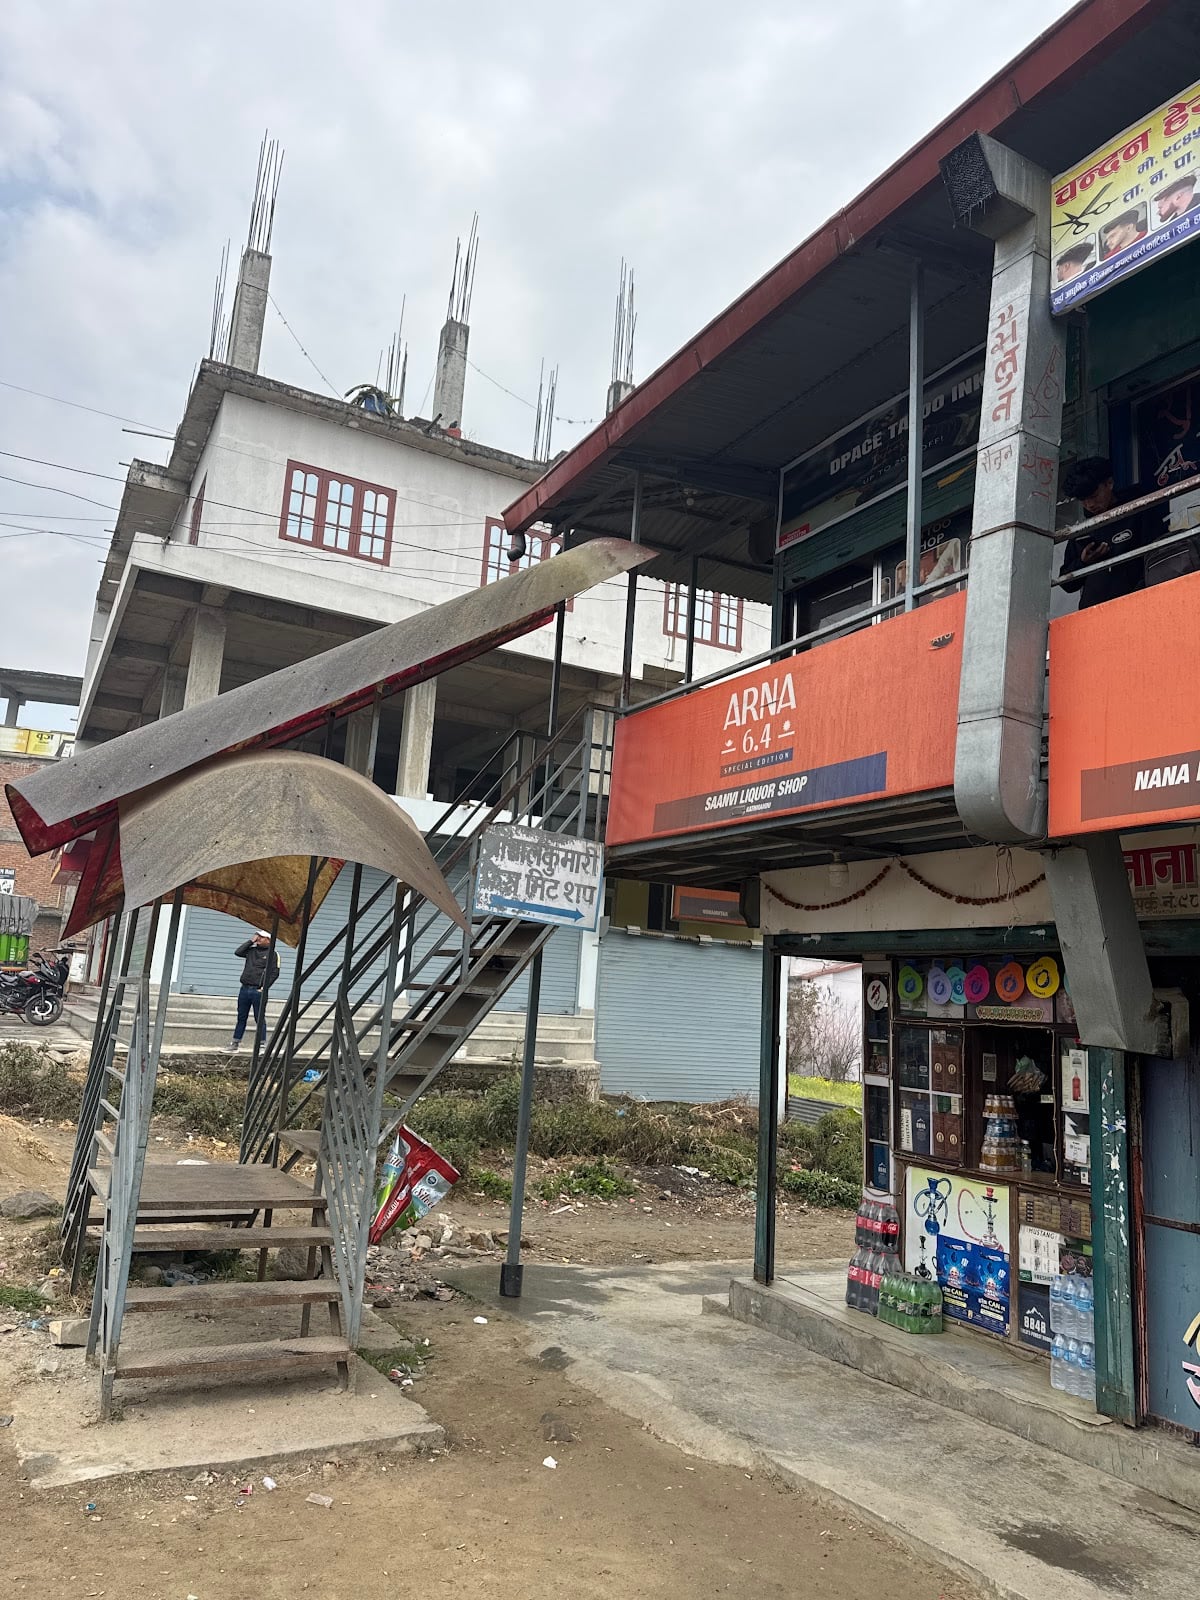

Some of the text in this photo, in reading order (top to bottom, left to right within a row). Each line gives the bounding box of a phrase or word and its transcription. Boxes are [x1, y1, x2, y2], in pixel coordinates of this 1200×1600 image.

[1054, 128, 1152, 207] चन्दन
[887, 394, 946, 440] TAOO
[920, 533, 945, 551] HOP
[723, 673, 797, 731] ARNA
[742, 722, 771, 754] 6.4
[723, 752, 790, 775] SPECIAL EDITION
[1134, 763, 1190, 792] NANA
[704, 791, 738, 811] SAANVI
[739, 783, 776, 804] LIQUOR
[777, 775, 808, 796] SHOP
